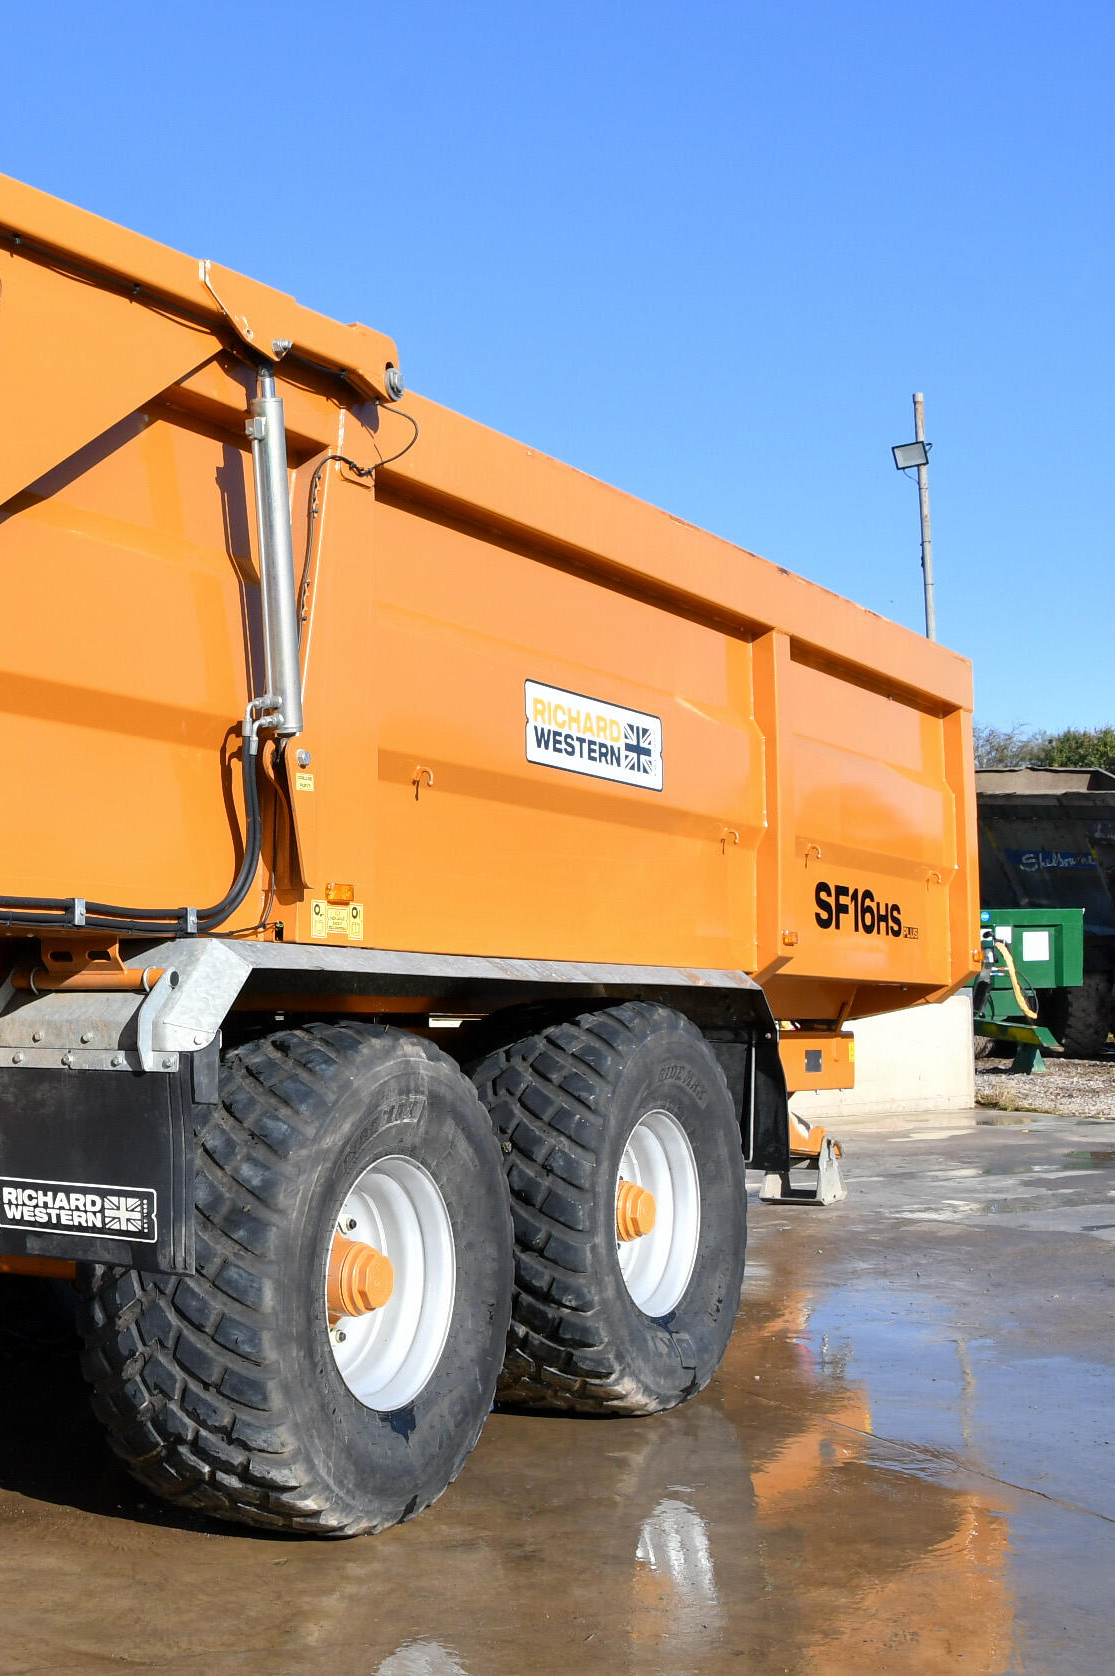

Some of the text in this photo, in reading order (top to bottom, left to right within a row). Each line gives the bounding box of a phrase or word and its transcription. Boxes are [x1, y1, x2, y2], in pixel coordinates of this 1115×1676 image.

[533, 697, 621, 742] RICHARD
[534, 725, 621, 767] WESTERN
[815, 881, 902, 938] SF16HS
[2, 1187, 102, 1212] RICHARD
[3, 1204, 103, 1228] WESTERN
